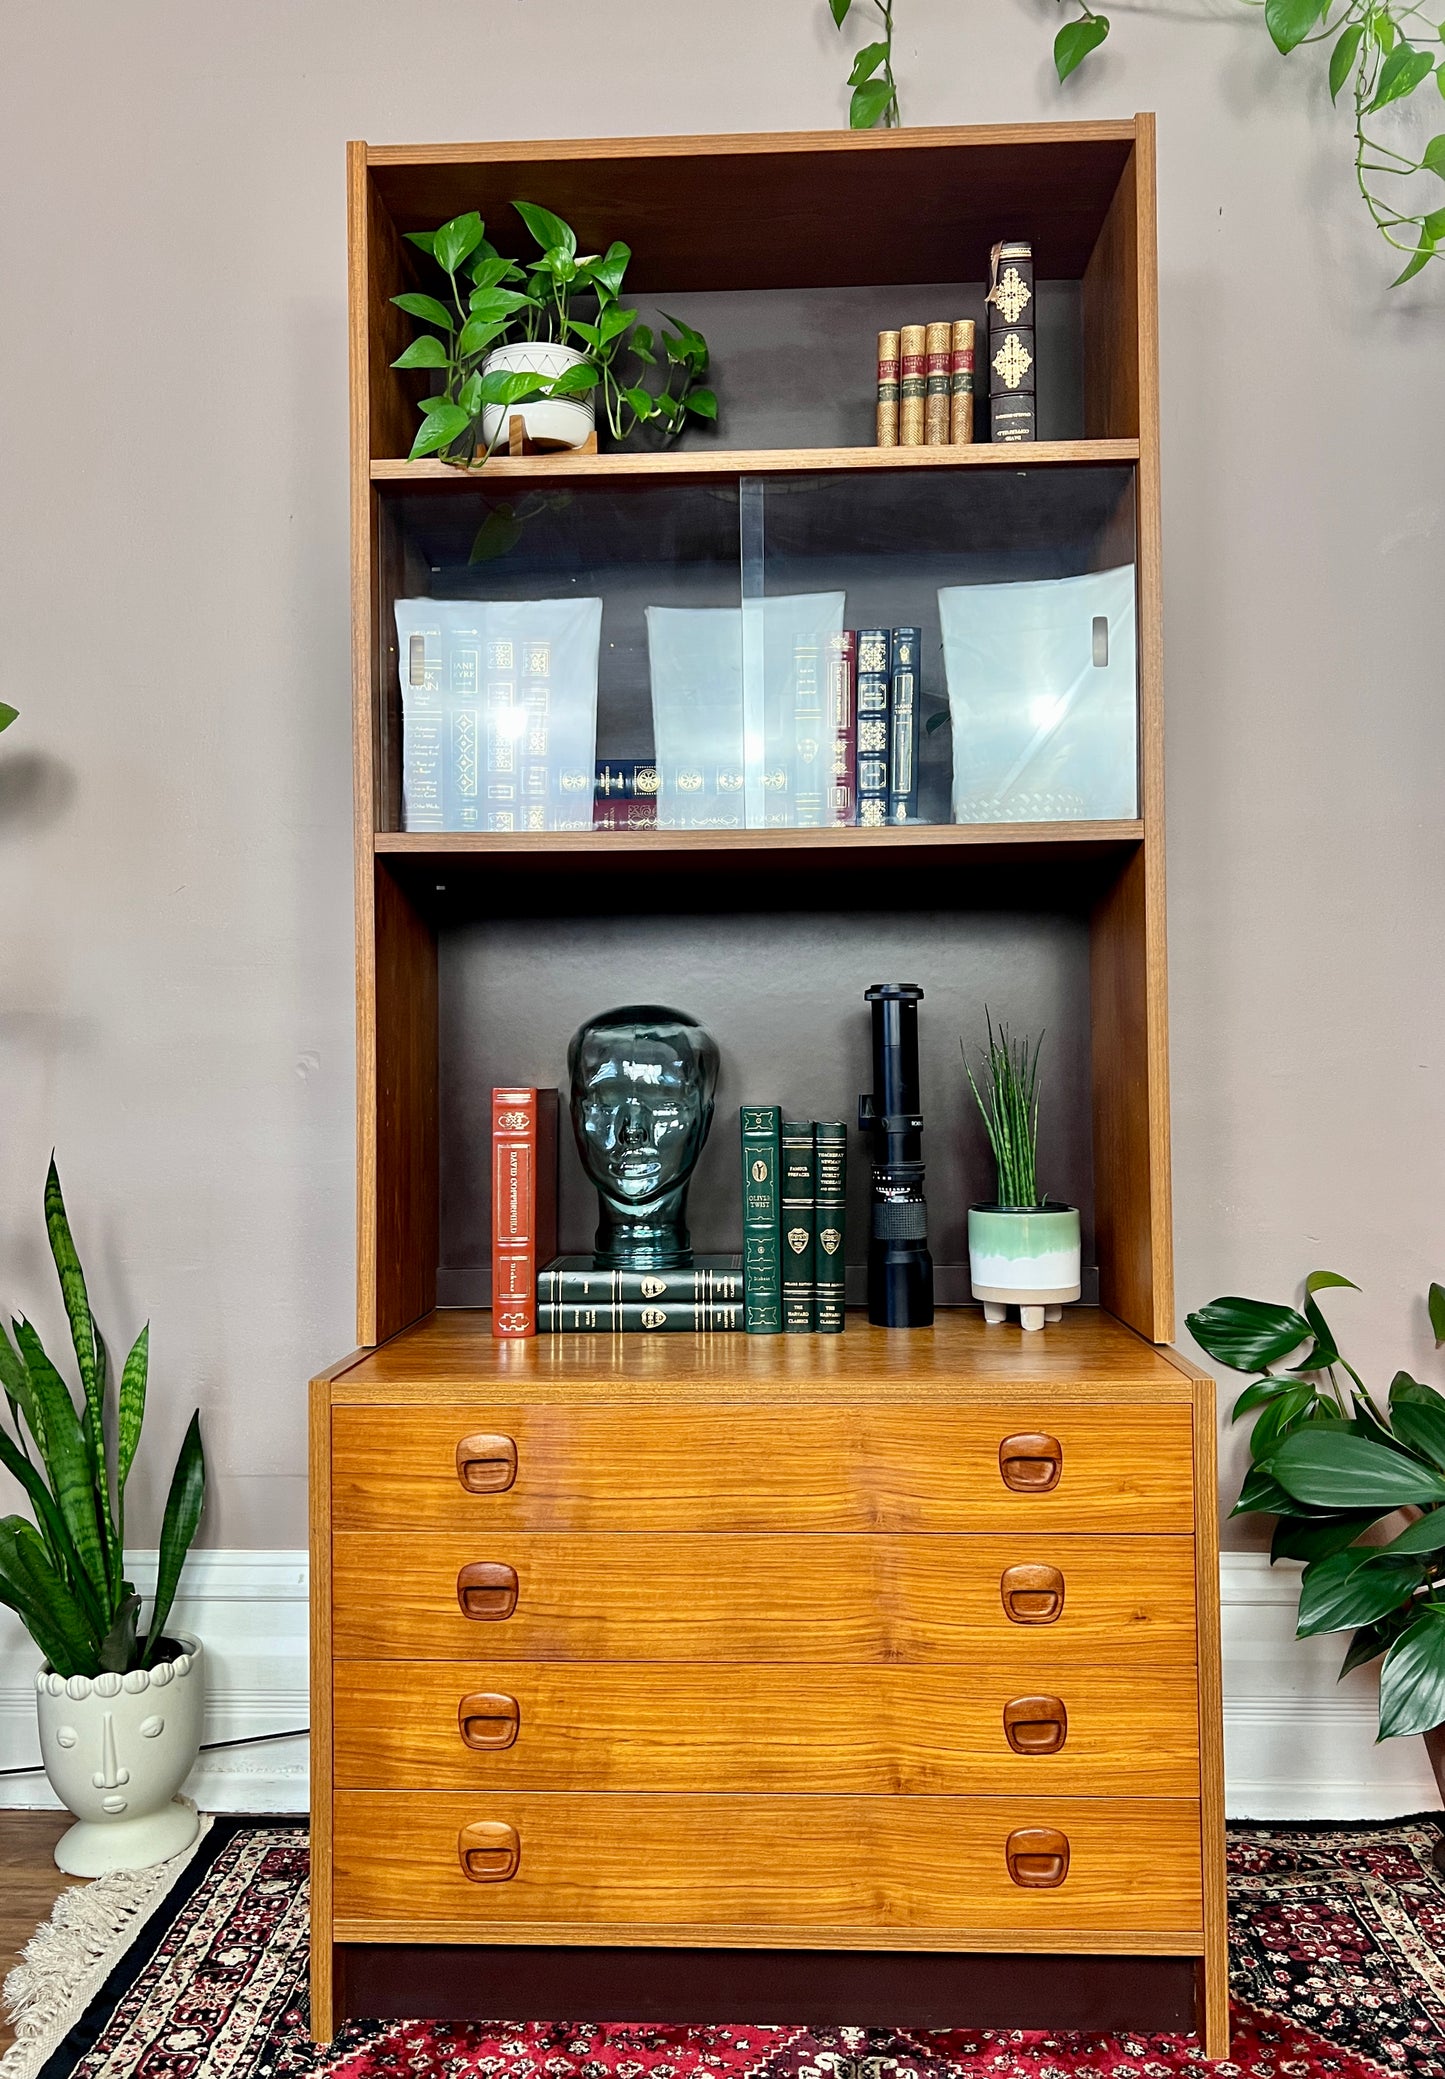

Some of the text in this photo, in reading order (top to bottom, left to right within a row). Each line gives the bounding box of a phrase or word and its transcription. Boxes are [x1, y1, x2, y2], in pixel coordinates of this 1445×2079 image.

[510, 1151, 518, 1234] DAVID COPPERFIELD
[748, 1194, 771, 1202] OLIVER
